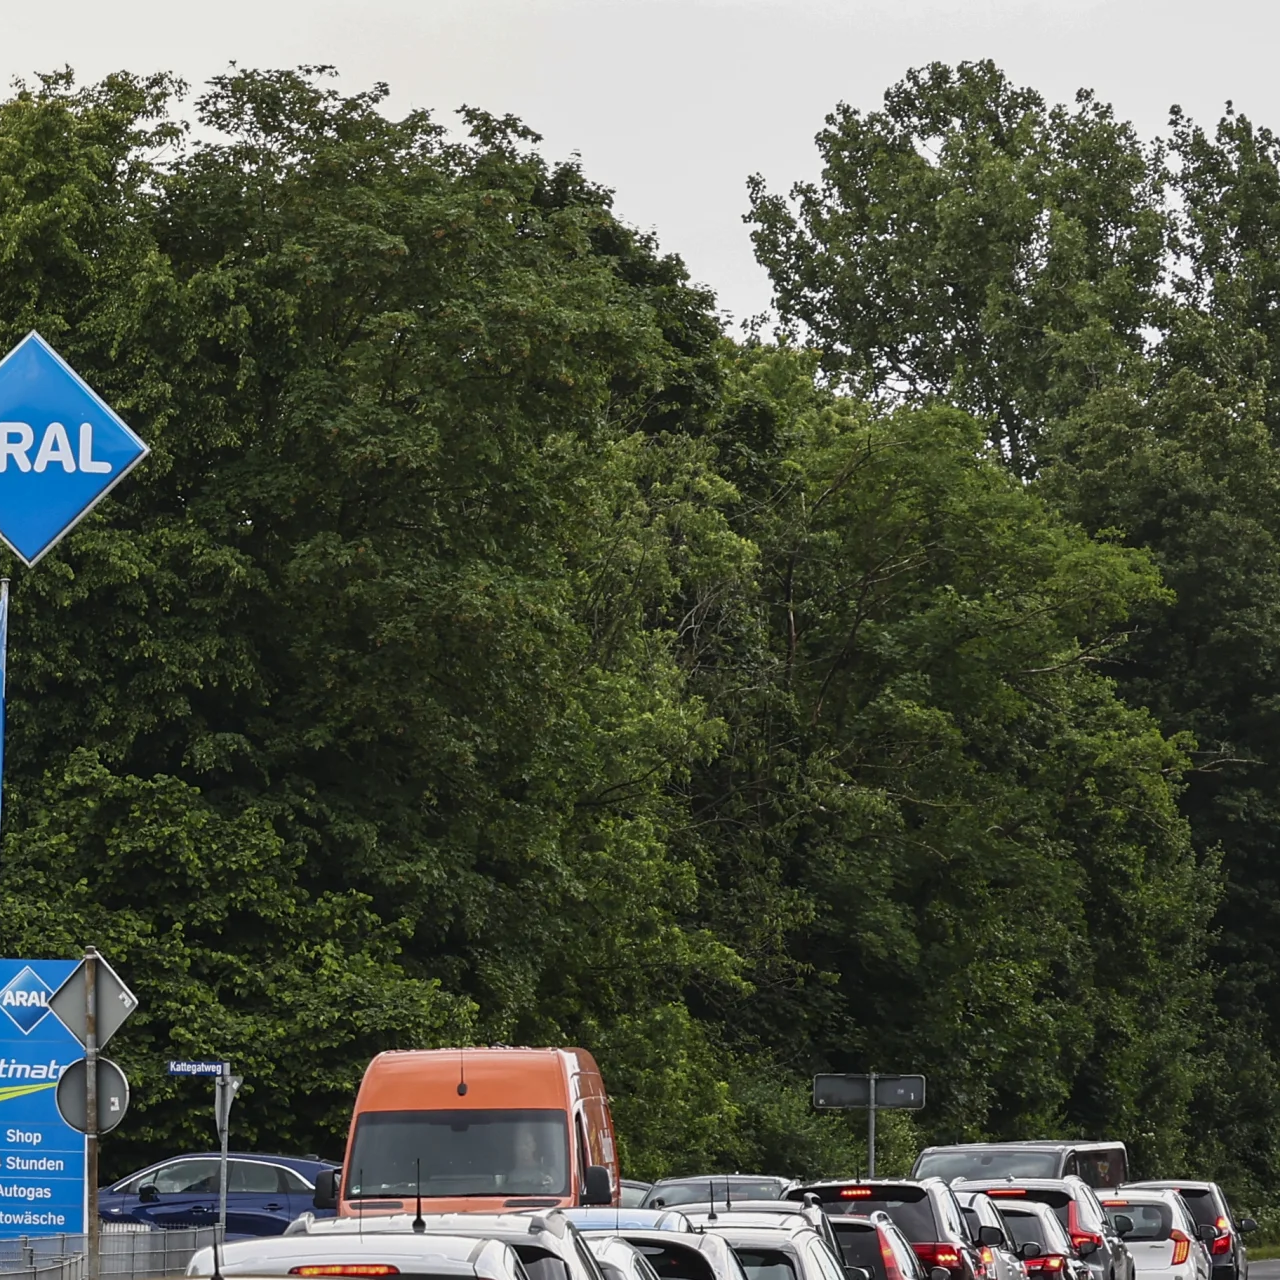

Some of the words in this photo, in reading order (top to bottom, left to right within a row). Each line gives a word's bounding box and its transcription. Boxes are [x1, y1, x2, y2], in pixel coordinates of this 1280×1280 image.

[2, 990, 48, 1007] ARAL
[170, 1061, 222, 1075] Kattegatweg
[6, 1129, 42, 1147] Shop
[5, 1156, 64, 1171] Stunden
